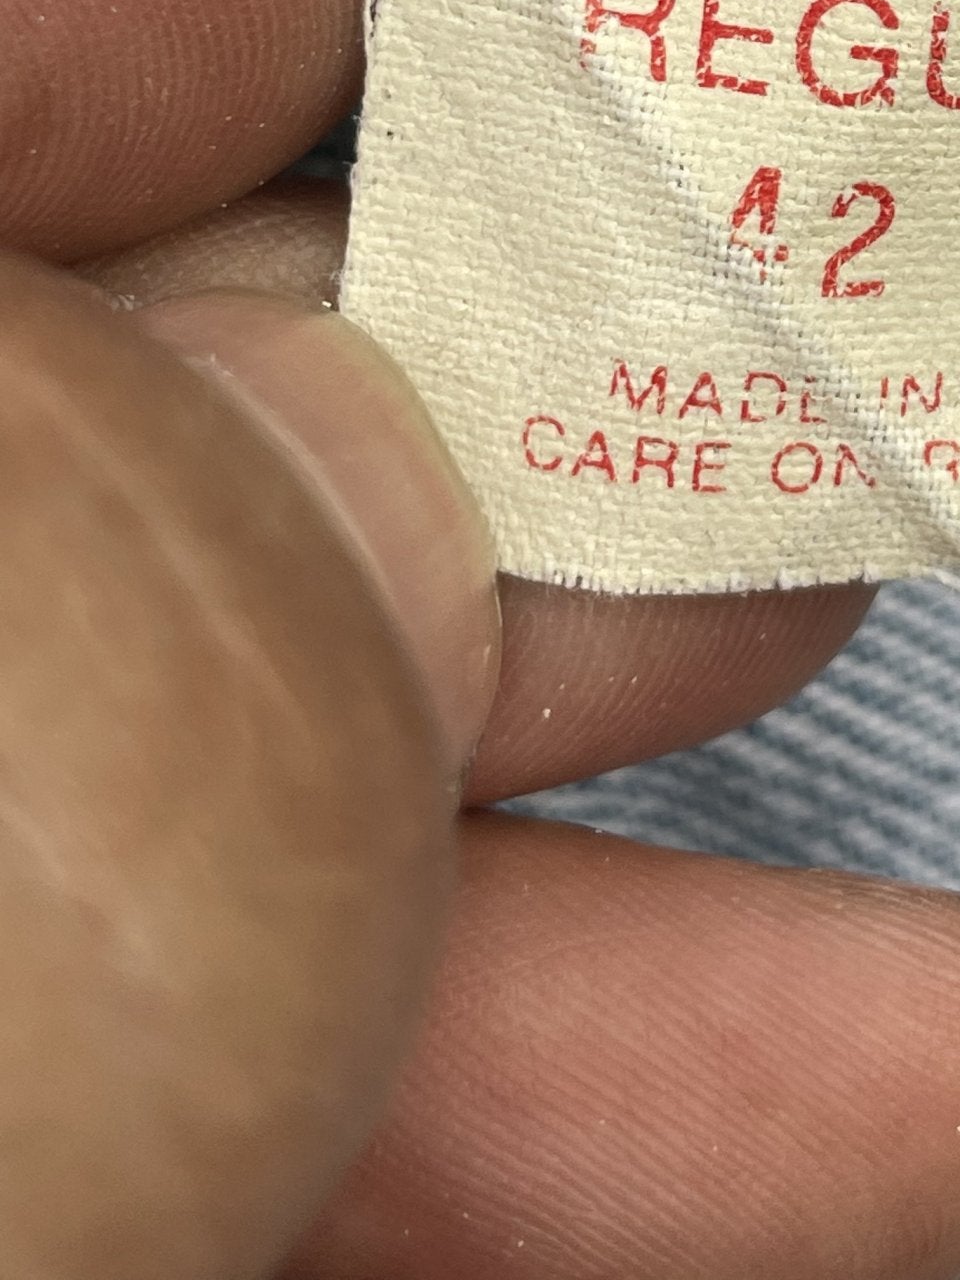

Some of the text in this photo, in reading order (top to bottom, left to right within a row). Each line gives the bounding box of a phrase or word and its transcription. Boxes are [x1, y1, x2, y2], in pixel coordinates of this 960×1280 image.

[728, 165, 896, 299] 42
[608, 358, 828, 424] MADE
[878, 372, 945, 417] IN
[520, 416, 732, 493] CARE
